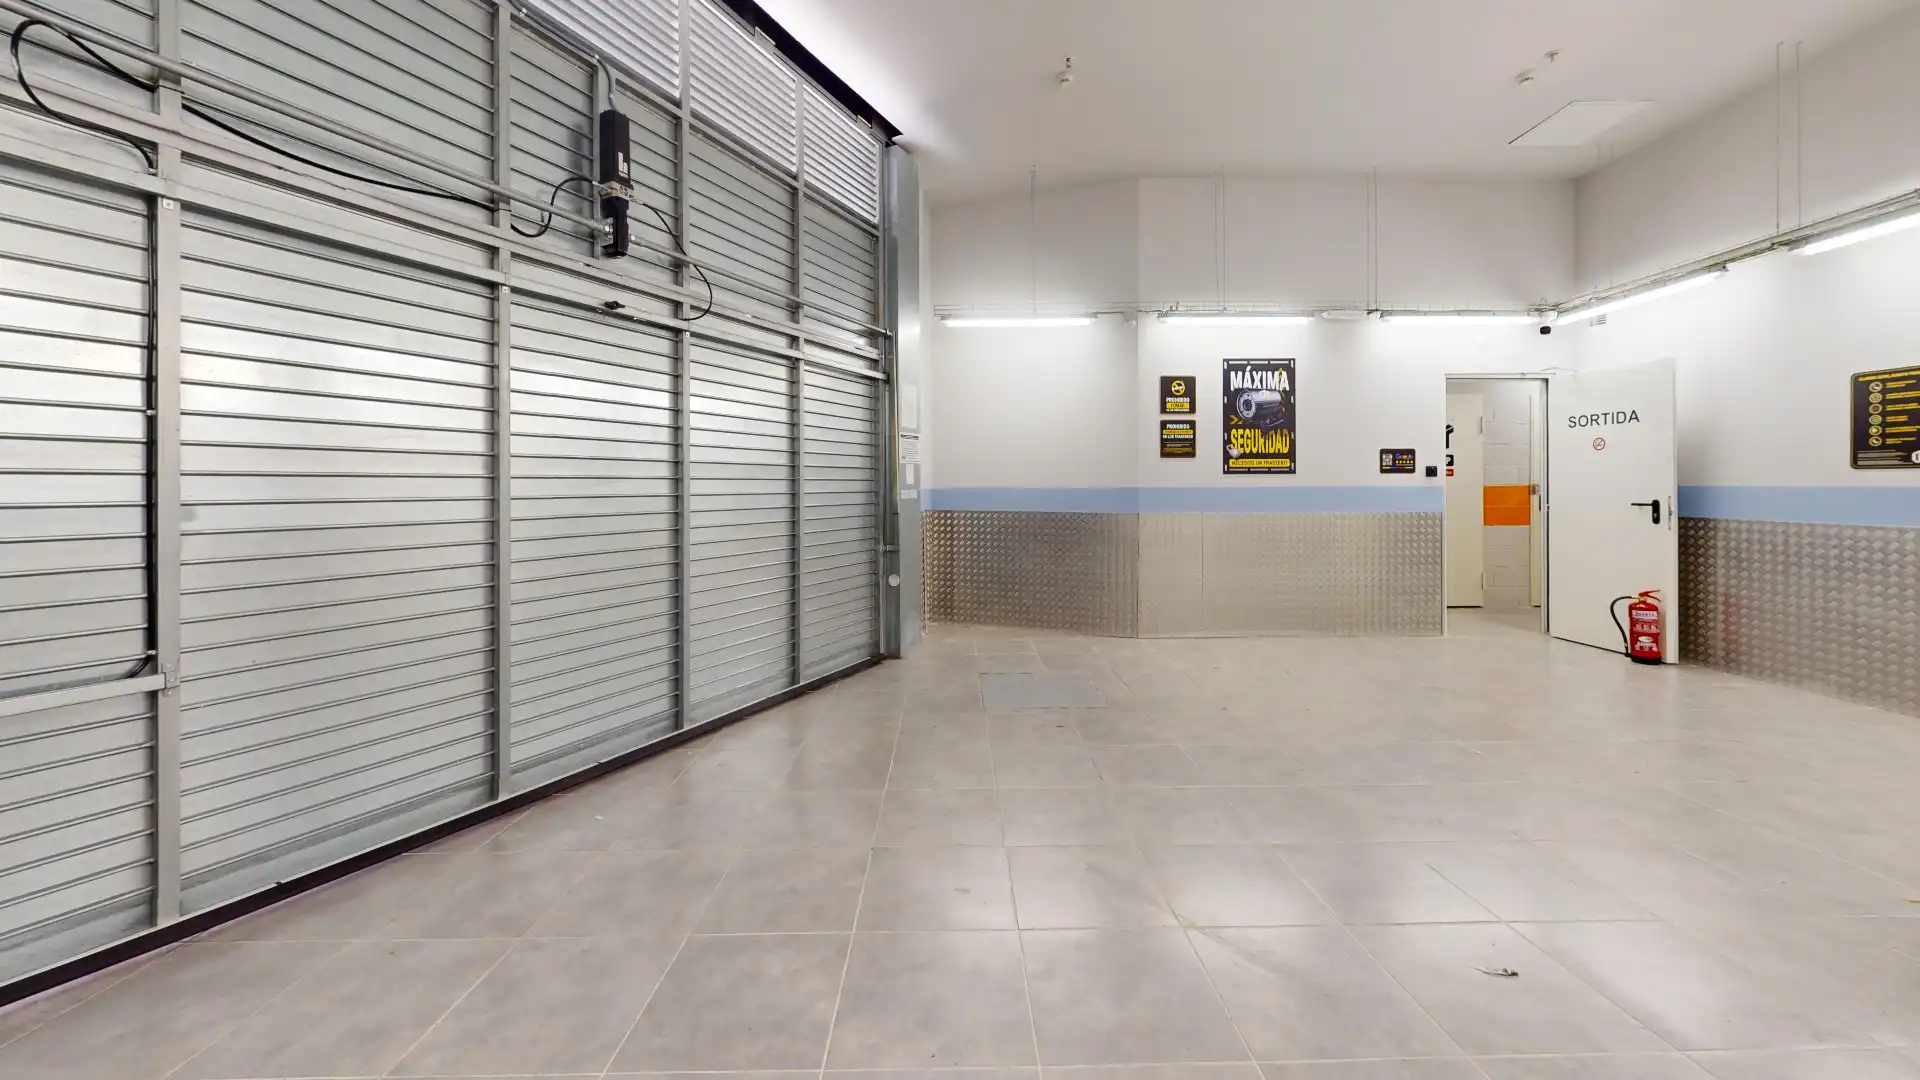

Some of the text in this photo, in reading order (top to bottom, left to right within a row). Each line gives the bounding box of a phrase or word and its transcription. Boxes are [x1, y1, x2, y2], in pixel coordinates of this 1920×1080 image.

[1230, 365, 1289, 391] MÁXIMA
[1568, 409, 1640, 428] SORTIDA
[1230, 428, 1289, 454] SEGURIDAD
[1395, 453, 1413, 461] Google
